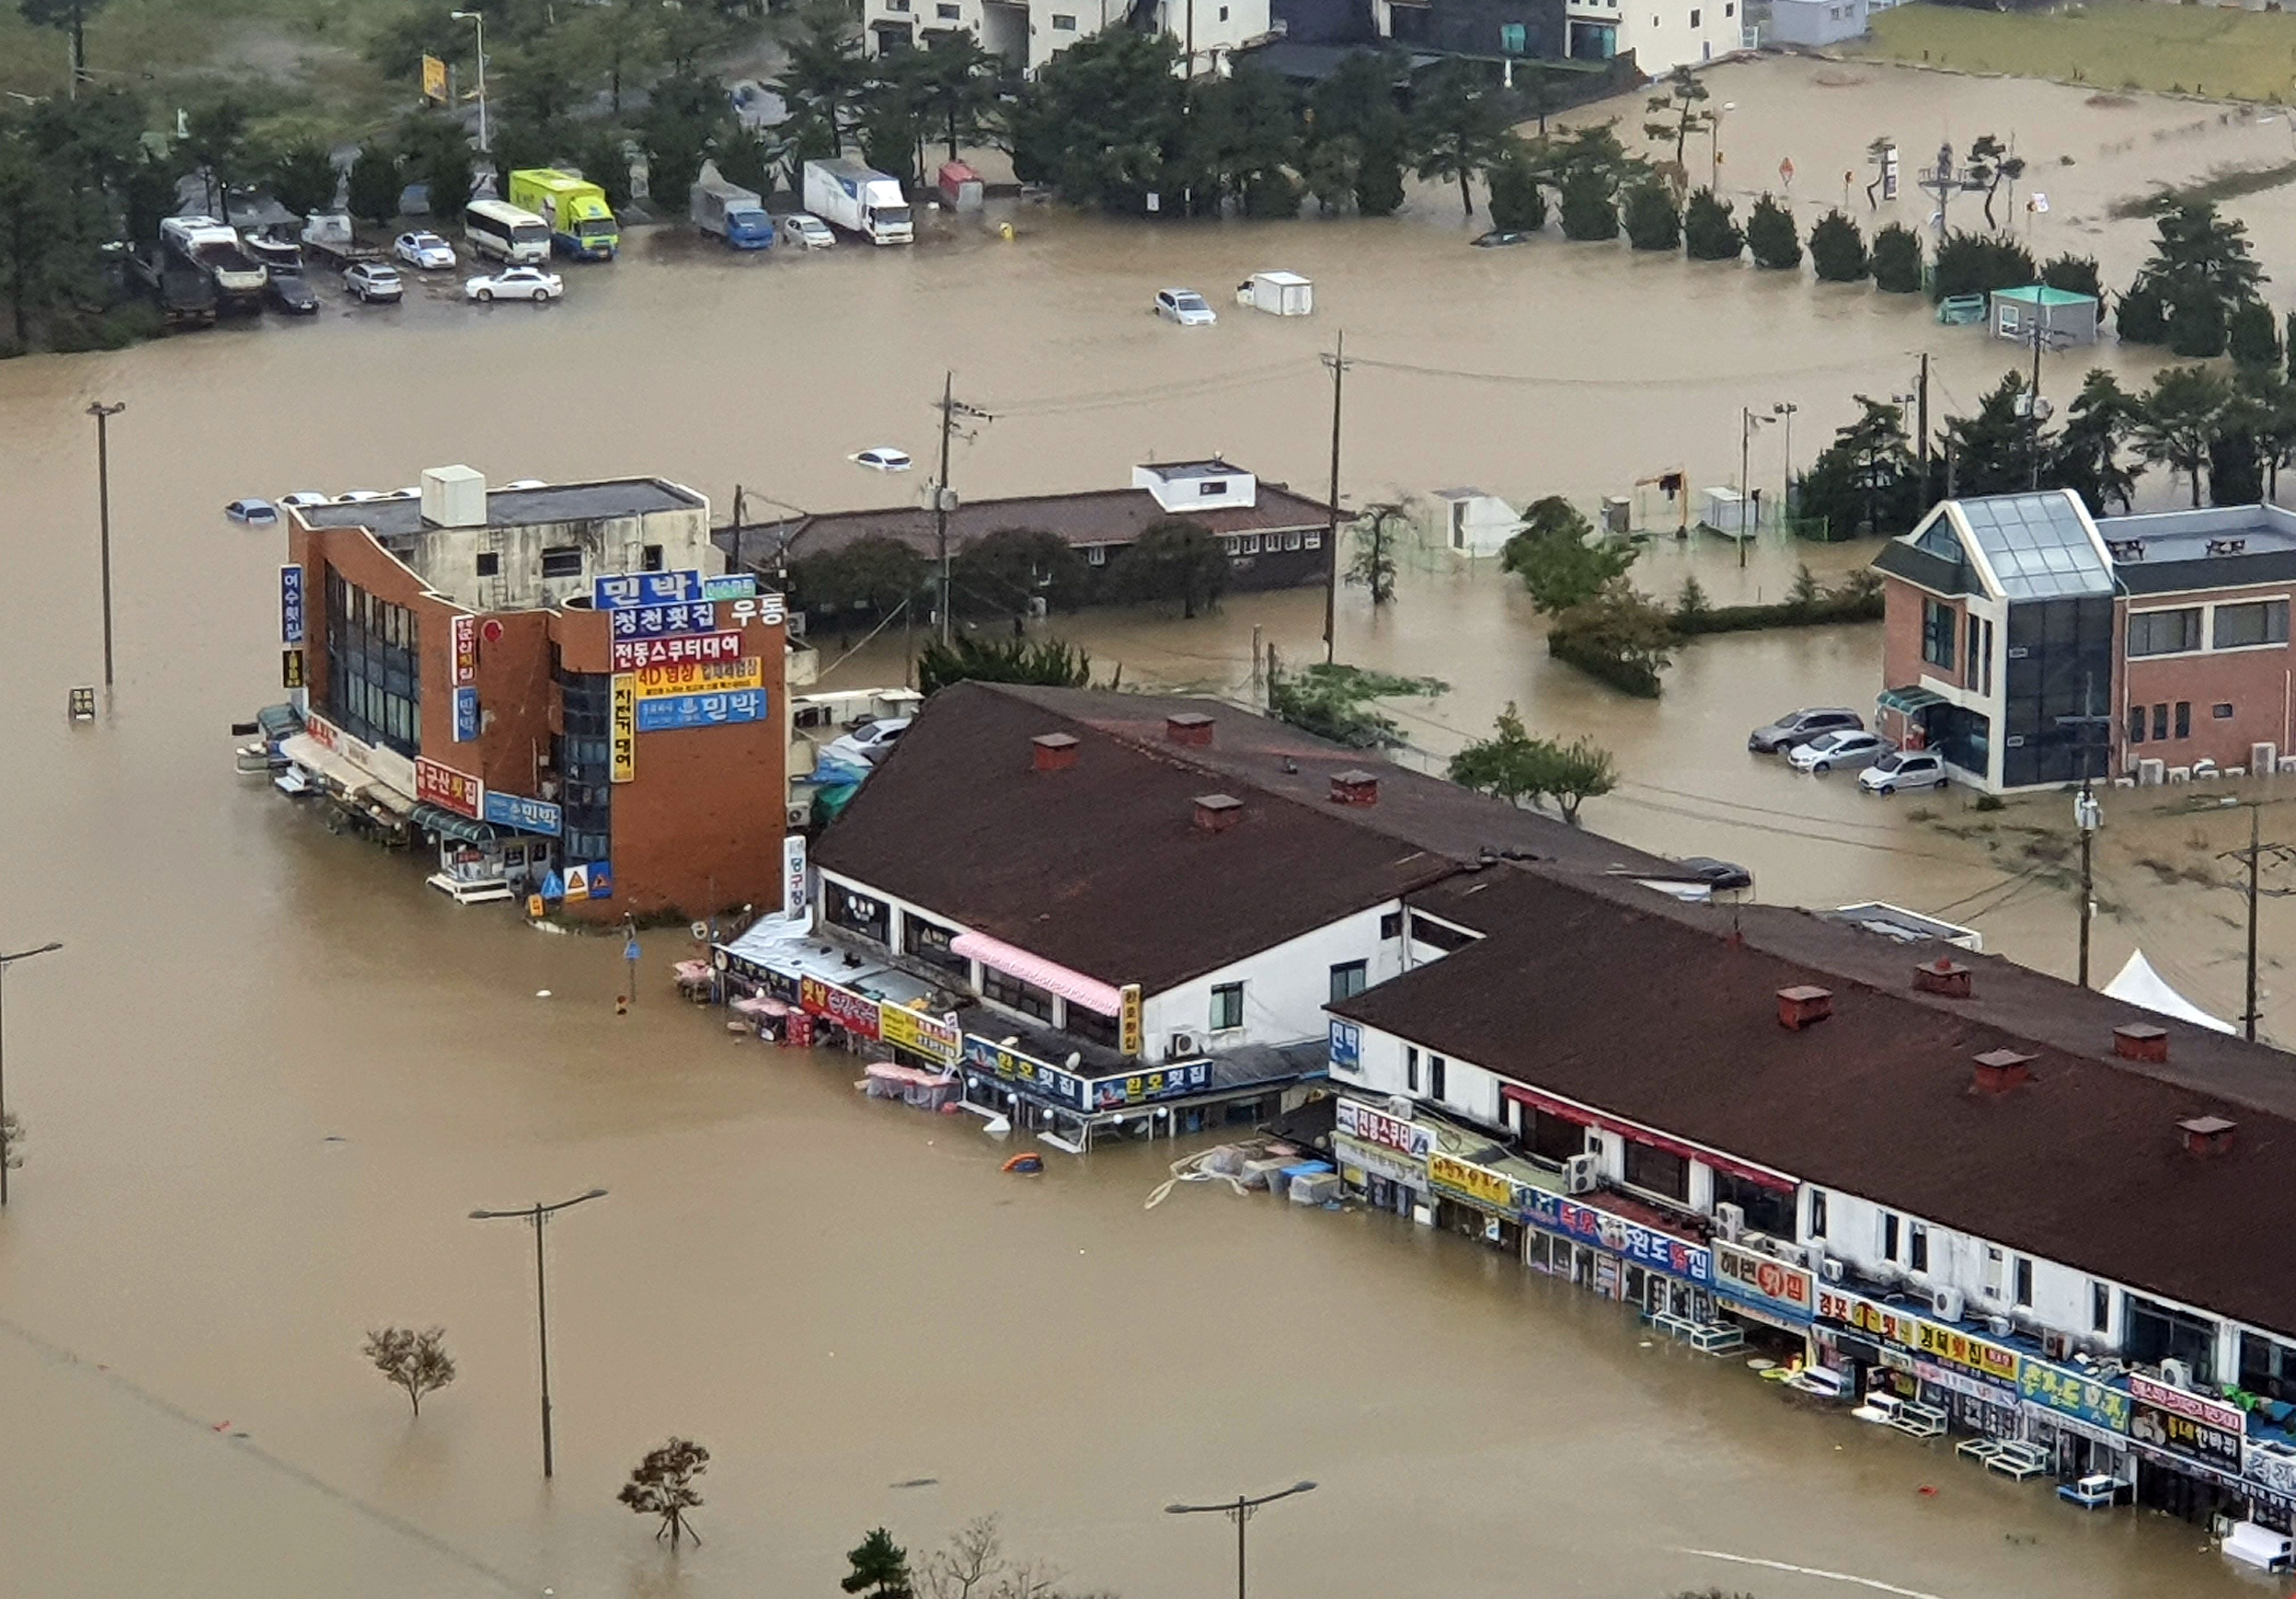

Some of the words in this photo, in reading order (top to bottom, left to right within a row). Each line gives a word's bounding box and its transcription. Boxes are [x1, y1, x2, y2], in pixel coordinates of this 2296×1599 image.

[602, 574, 692, 606] 민박
[731, 597, 785, 627] 우동
[615, 635, 739, 669] 전동스쿠터대여
[615, 689, 631, 735] 자전거
[701, 691, 759, 721] 민박
[615, 739, 631, 768] 대여
[522, 802, 558, 829] 민박
[1331, 1022, 1357, 1055] 민박
